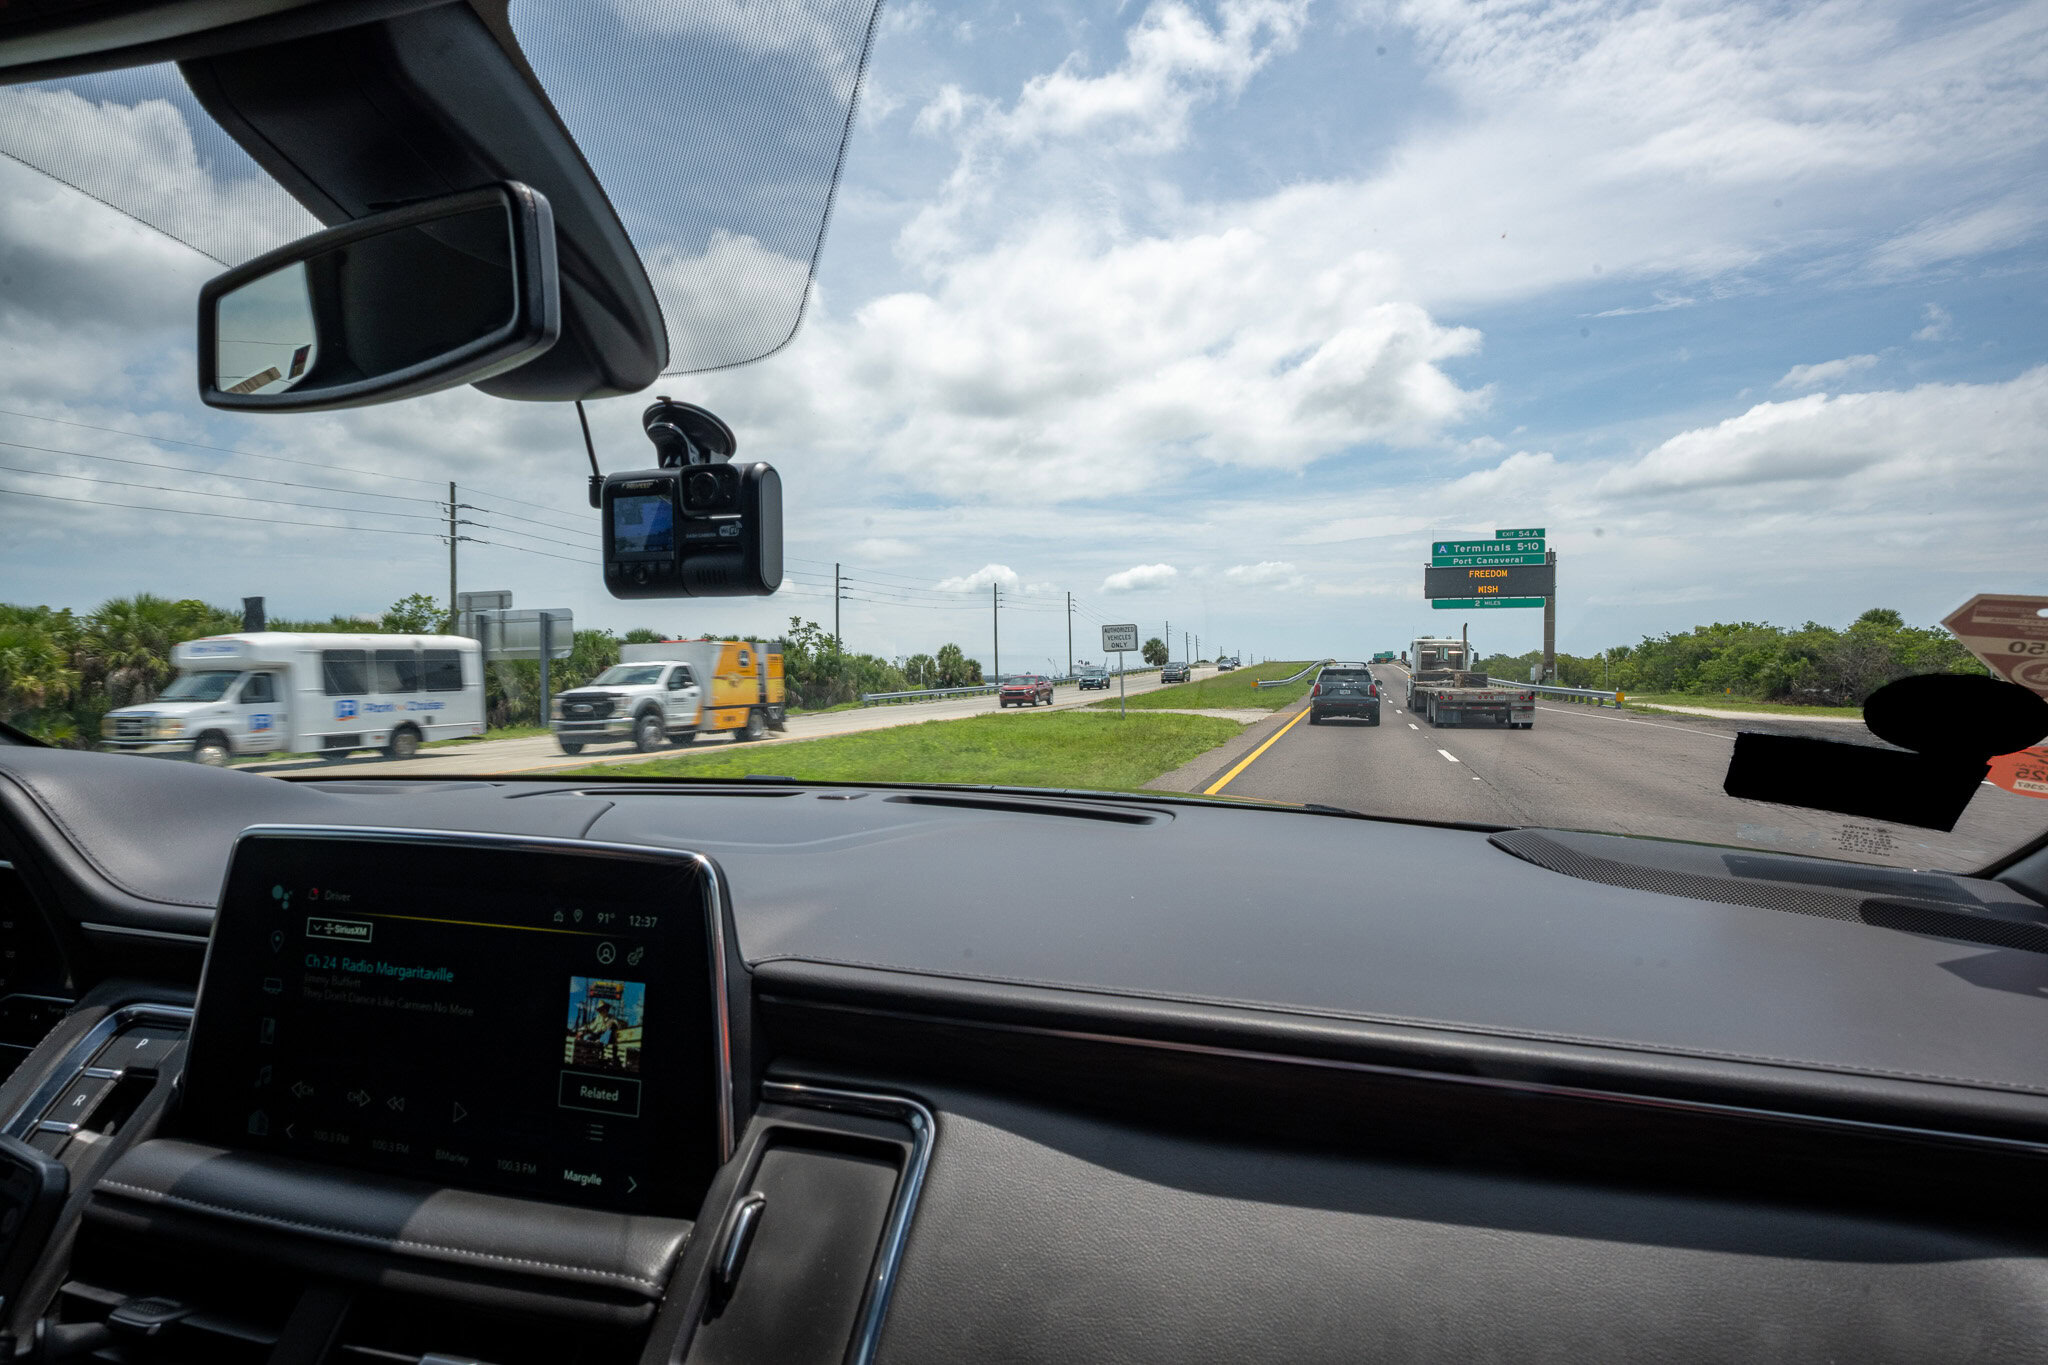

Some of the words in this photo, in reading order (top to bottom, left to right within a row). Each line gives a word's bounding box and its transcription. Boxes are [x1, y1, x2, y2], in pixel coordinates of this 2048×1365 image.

[1439, 545, 1447, 553] A
[1453, 544, 1511, 553] Terminals
[1517, 542, 1539, 551] 5-10
[1476, 556, 1524, 565] Canaveral
[1469, 570, 1508, 578] FREEDOM
[629, 915, 659, 929] 12:37
[334, 924, 368, 937] SiriusXM
[305, 954, 321, 969] Ch
[322, 955, 337, 970] 24
[342, 957, 374, 974] Radio
[375, 961, 455, 983] Margaritaville
[136, 1038, 149, 1049] P
[580, 1085, 619, 1102] Related
[72, 1094, 87, 1106] R
